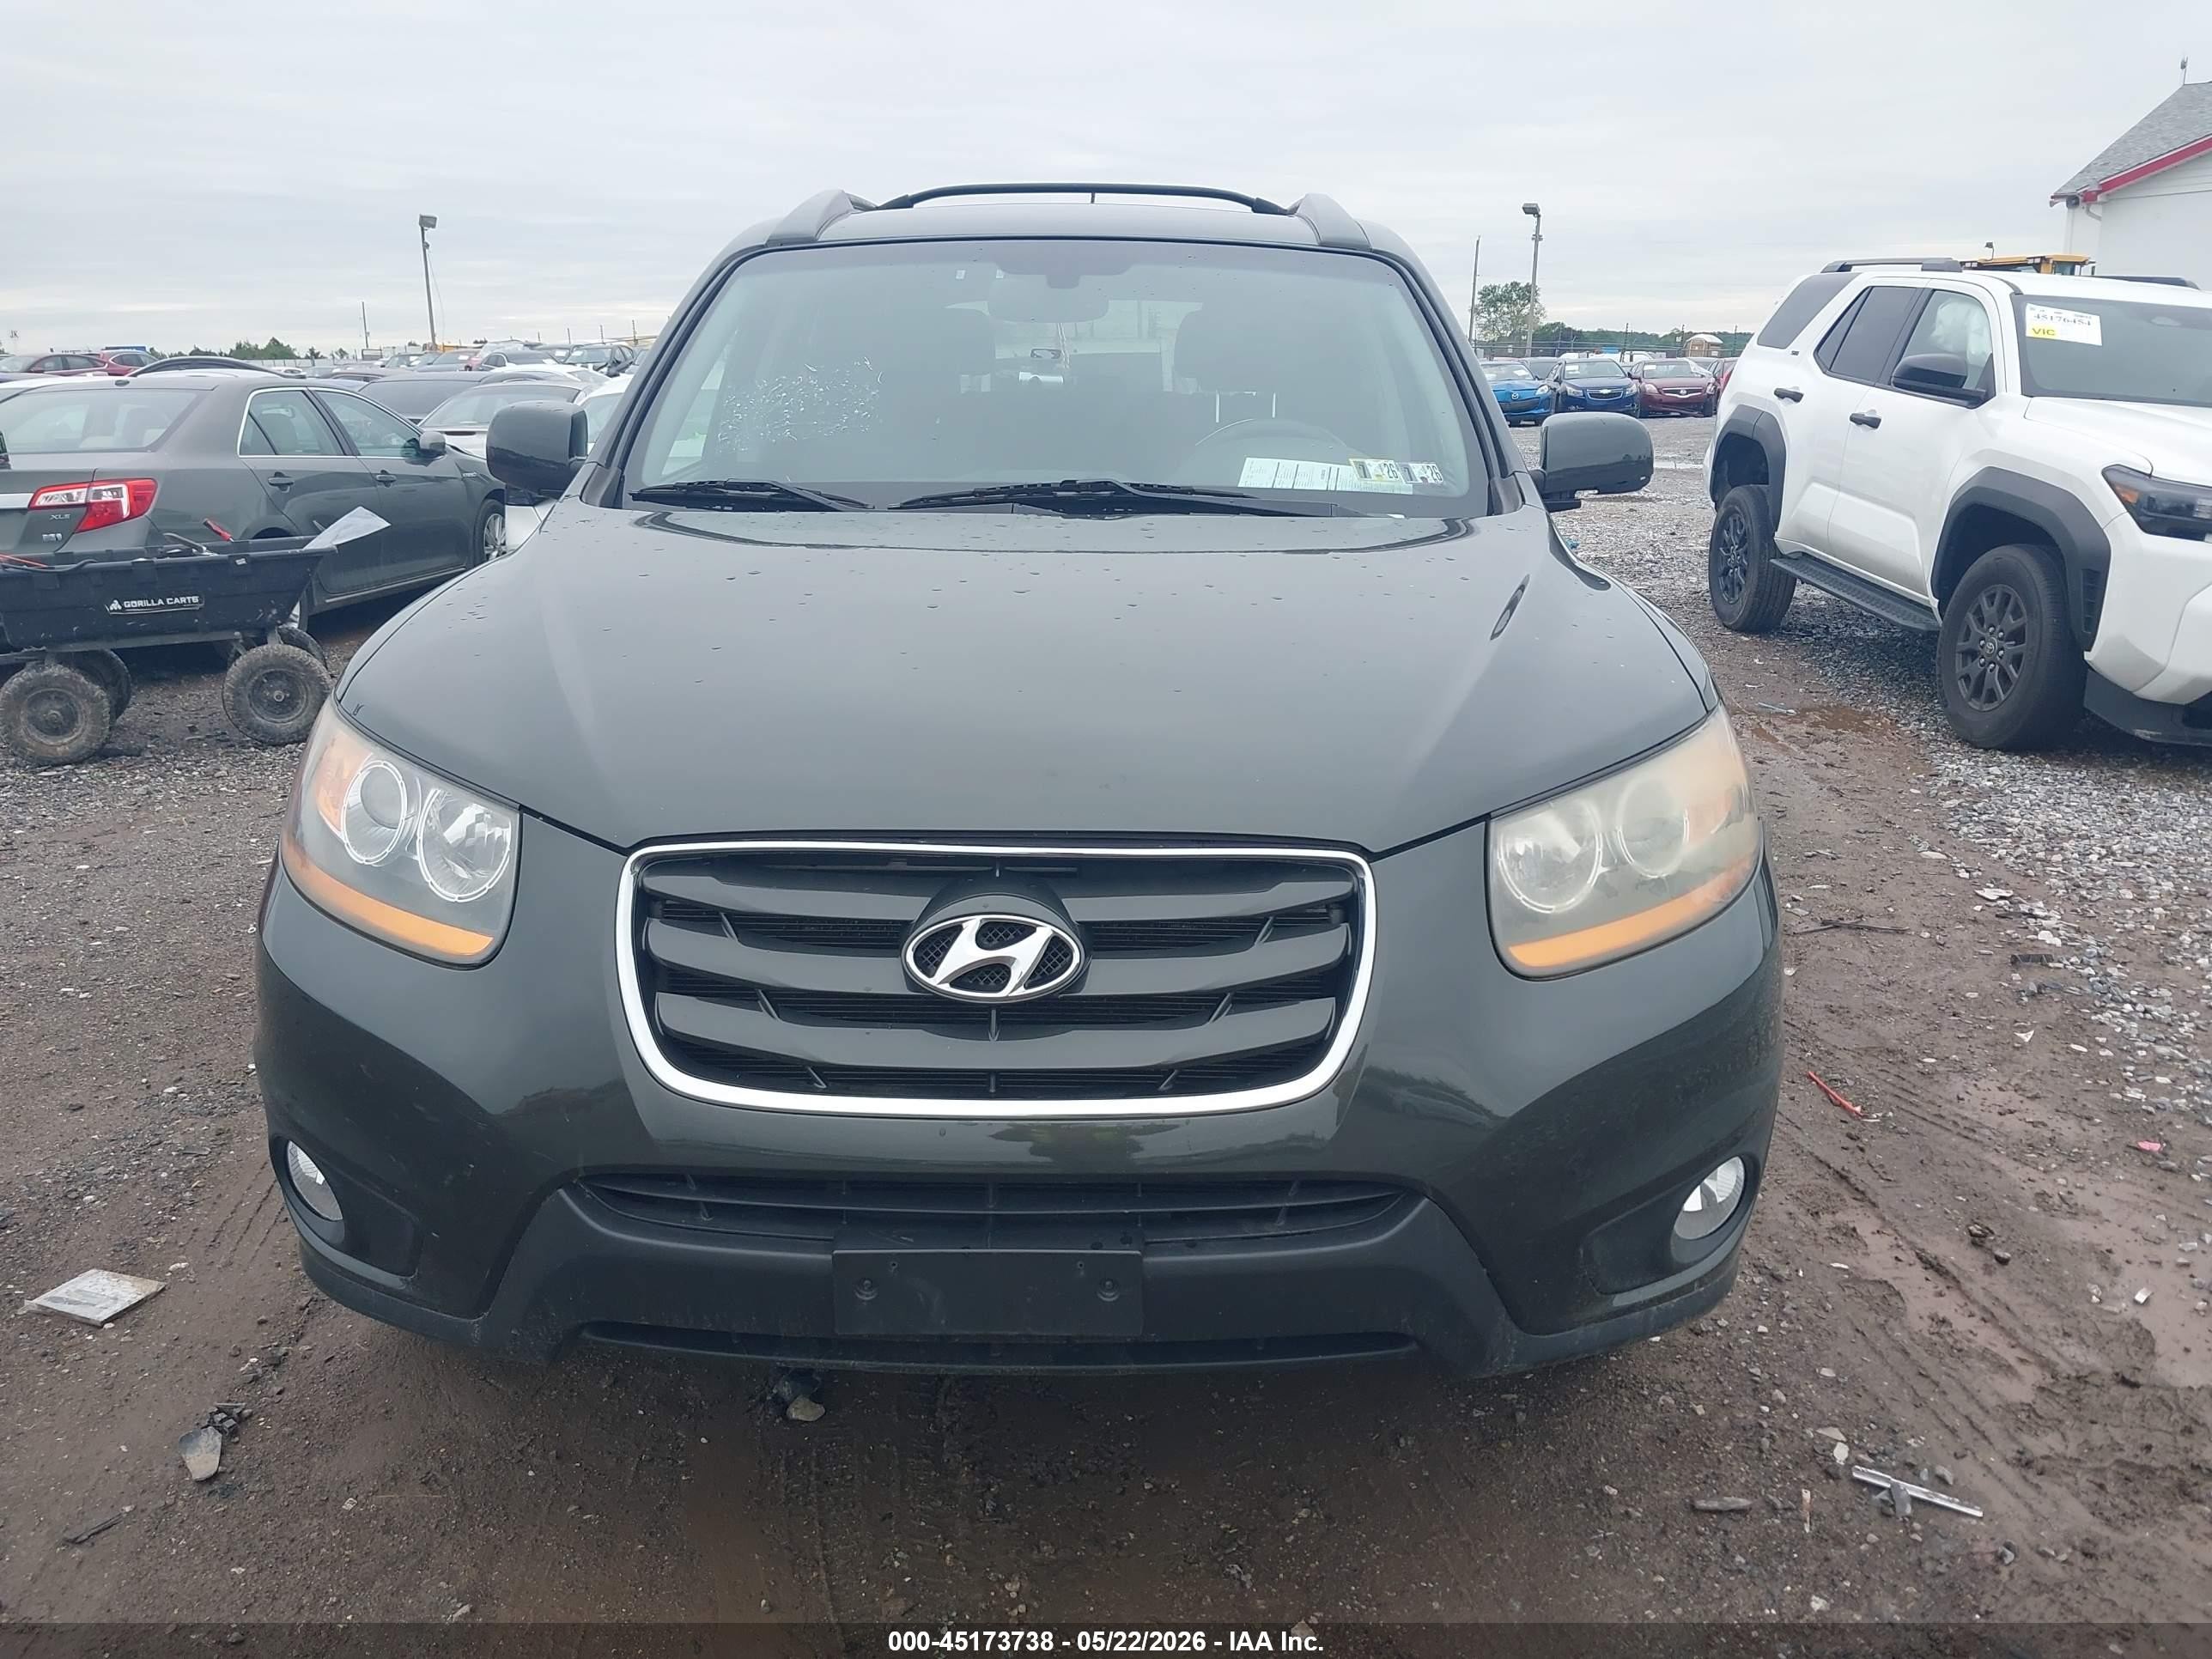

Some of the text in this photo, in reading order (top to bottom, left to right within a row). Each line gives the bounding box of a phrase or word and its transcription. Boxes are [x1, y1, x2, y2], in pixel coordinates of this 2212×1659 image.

[2032, 328, 2056, 337] VIC
[1382, 463, 1399, 479] 26
[1425, 465, 1443, 482] 26
[124, 596, 199, 609] GORILLA CARTS
